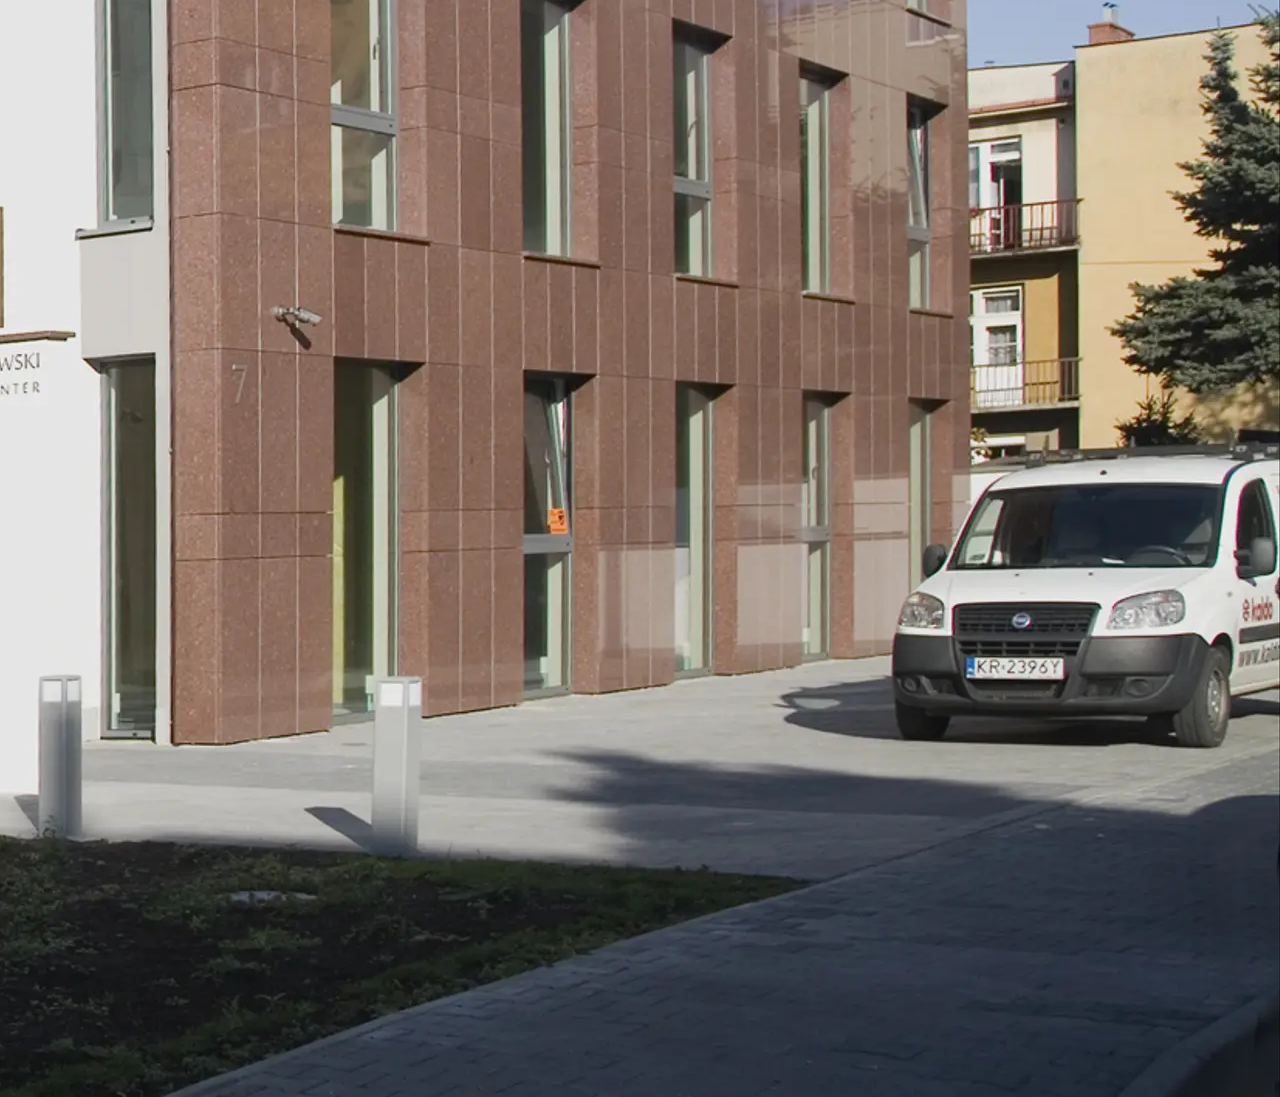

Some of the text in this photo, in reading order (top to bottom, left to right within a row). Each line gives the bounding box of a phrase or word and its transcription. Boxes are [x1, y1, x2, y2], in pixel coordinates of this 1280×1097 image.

[232, 364, 248, 403] 7
[977, 659, 1060, 674] KR 2396Y
